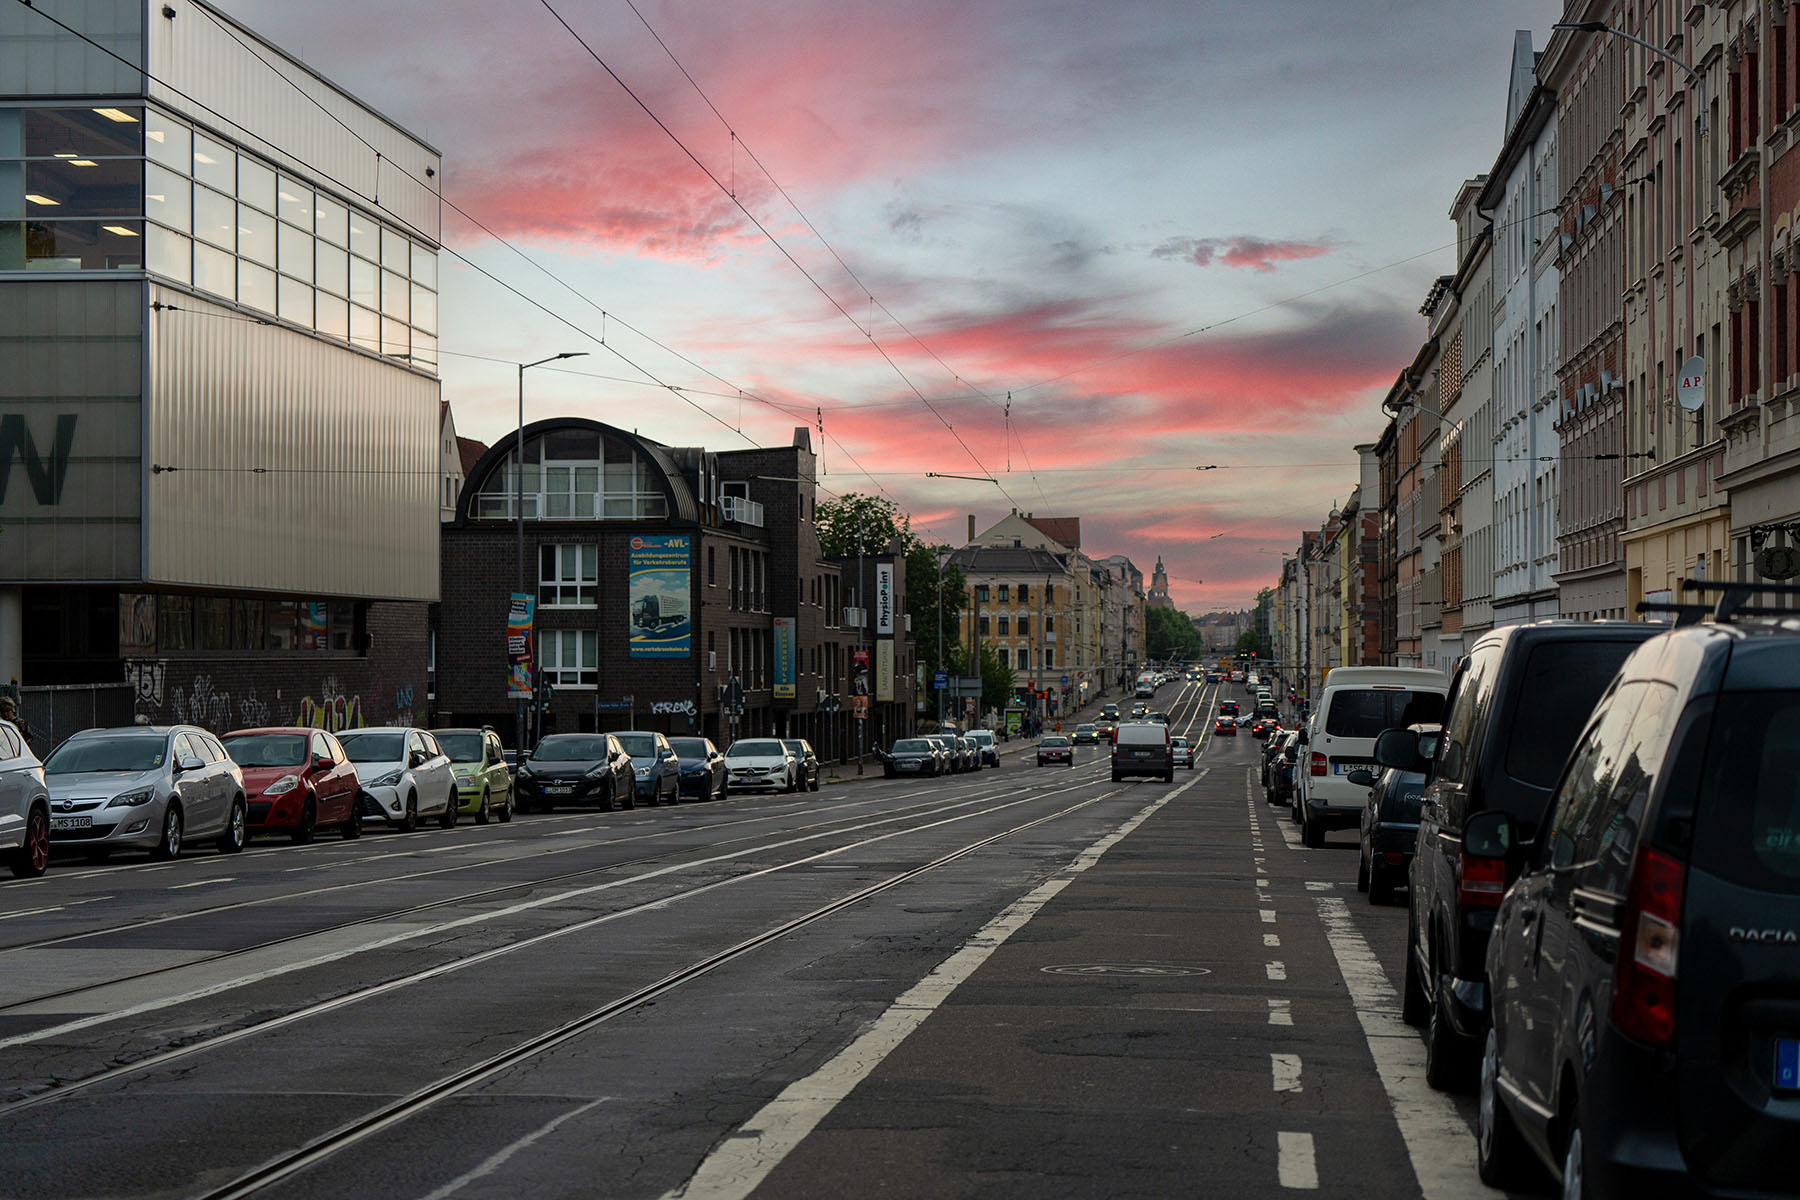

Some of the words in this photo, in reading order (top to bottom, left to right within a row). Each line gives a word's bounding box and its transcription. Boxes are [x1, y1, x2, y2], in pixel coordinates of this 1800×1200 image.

[1682, 375, 1704, 388] AP
[880, 571, 890, 627] PhysioPoint
[70, 818, 91, 827] 1108
[1728, 926, 1798, 944] DACIA
